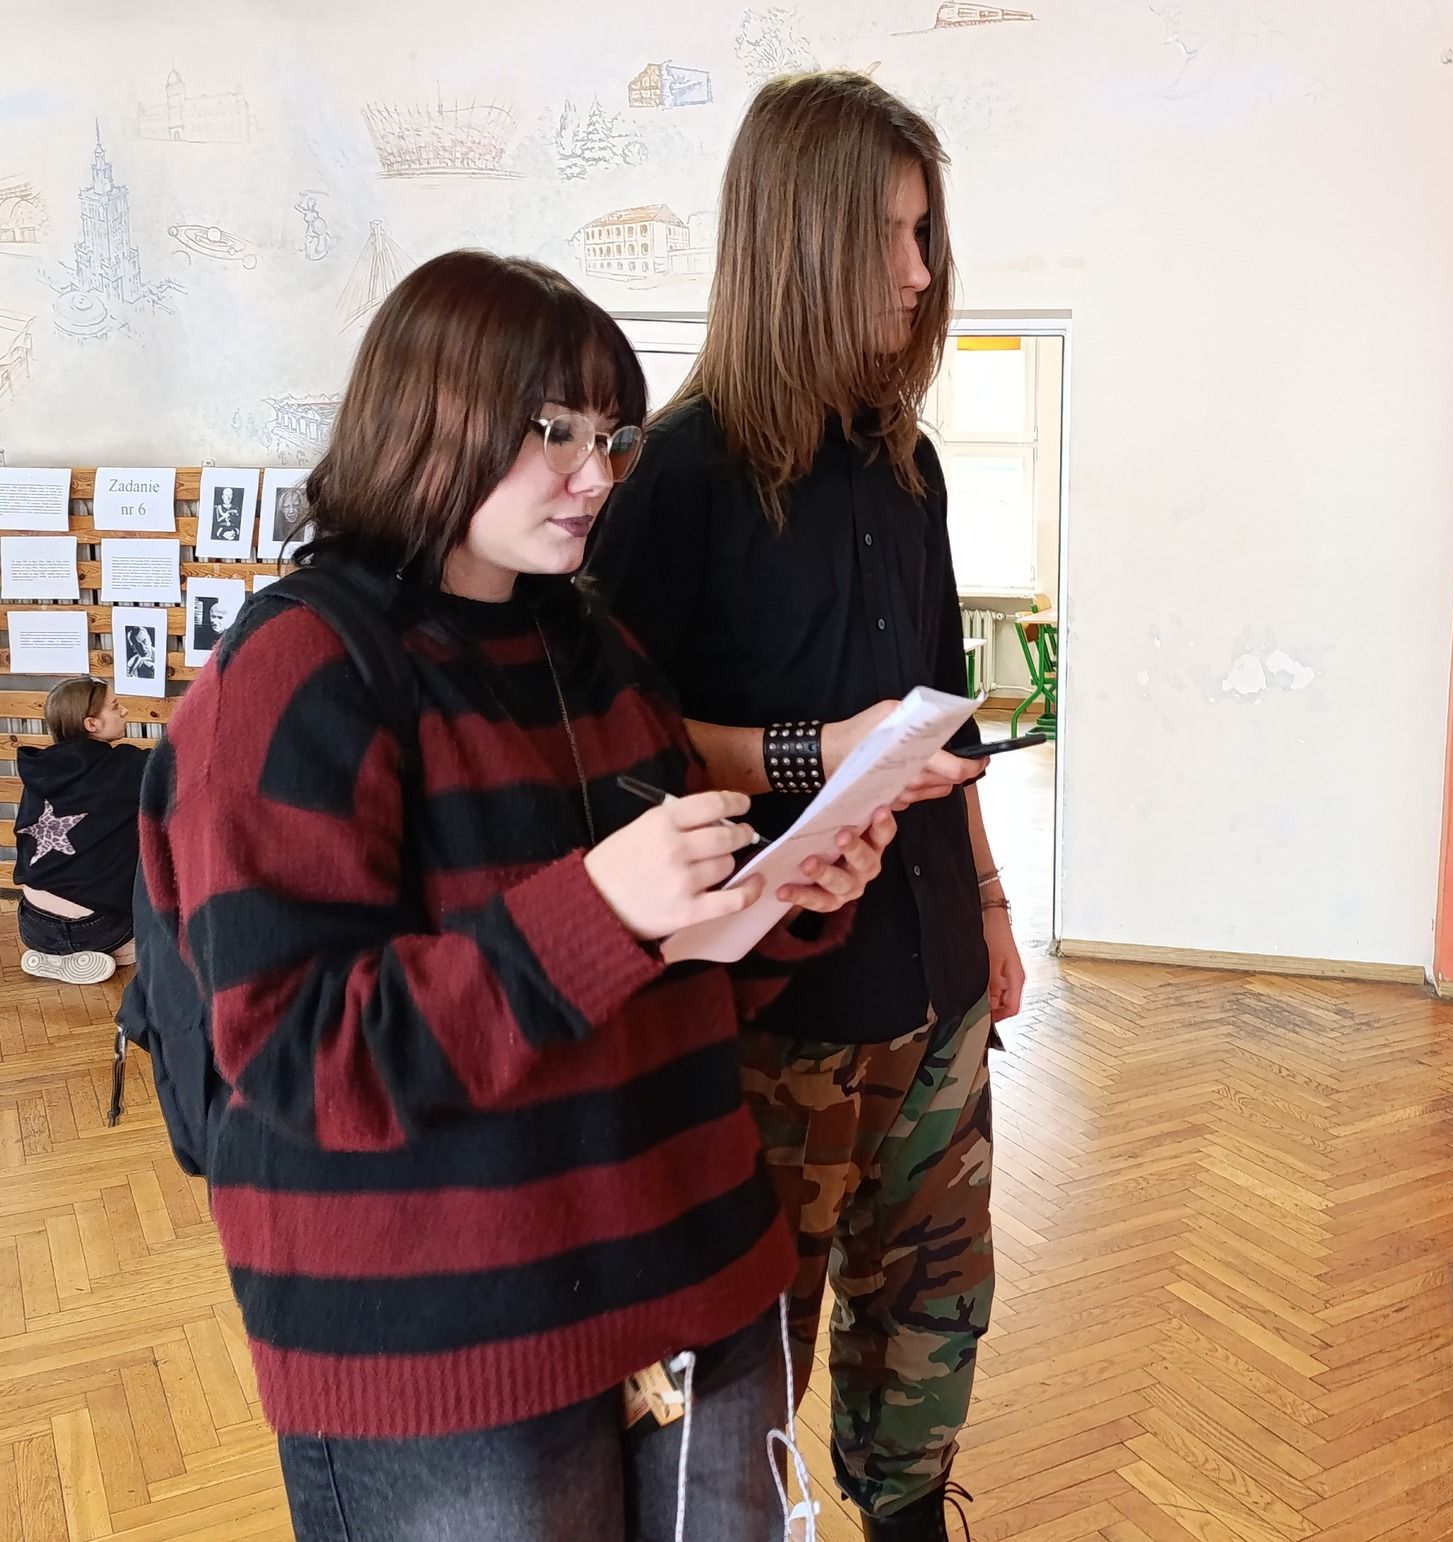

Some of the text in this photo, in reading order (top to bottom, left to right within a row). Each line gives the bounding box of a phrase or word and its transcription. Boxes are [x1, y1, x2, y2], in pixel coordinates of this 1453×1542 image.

[109, 479, 160, 493] Zadanie
[121, 502, 146, 516] nr 6
